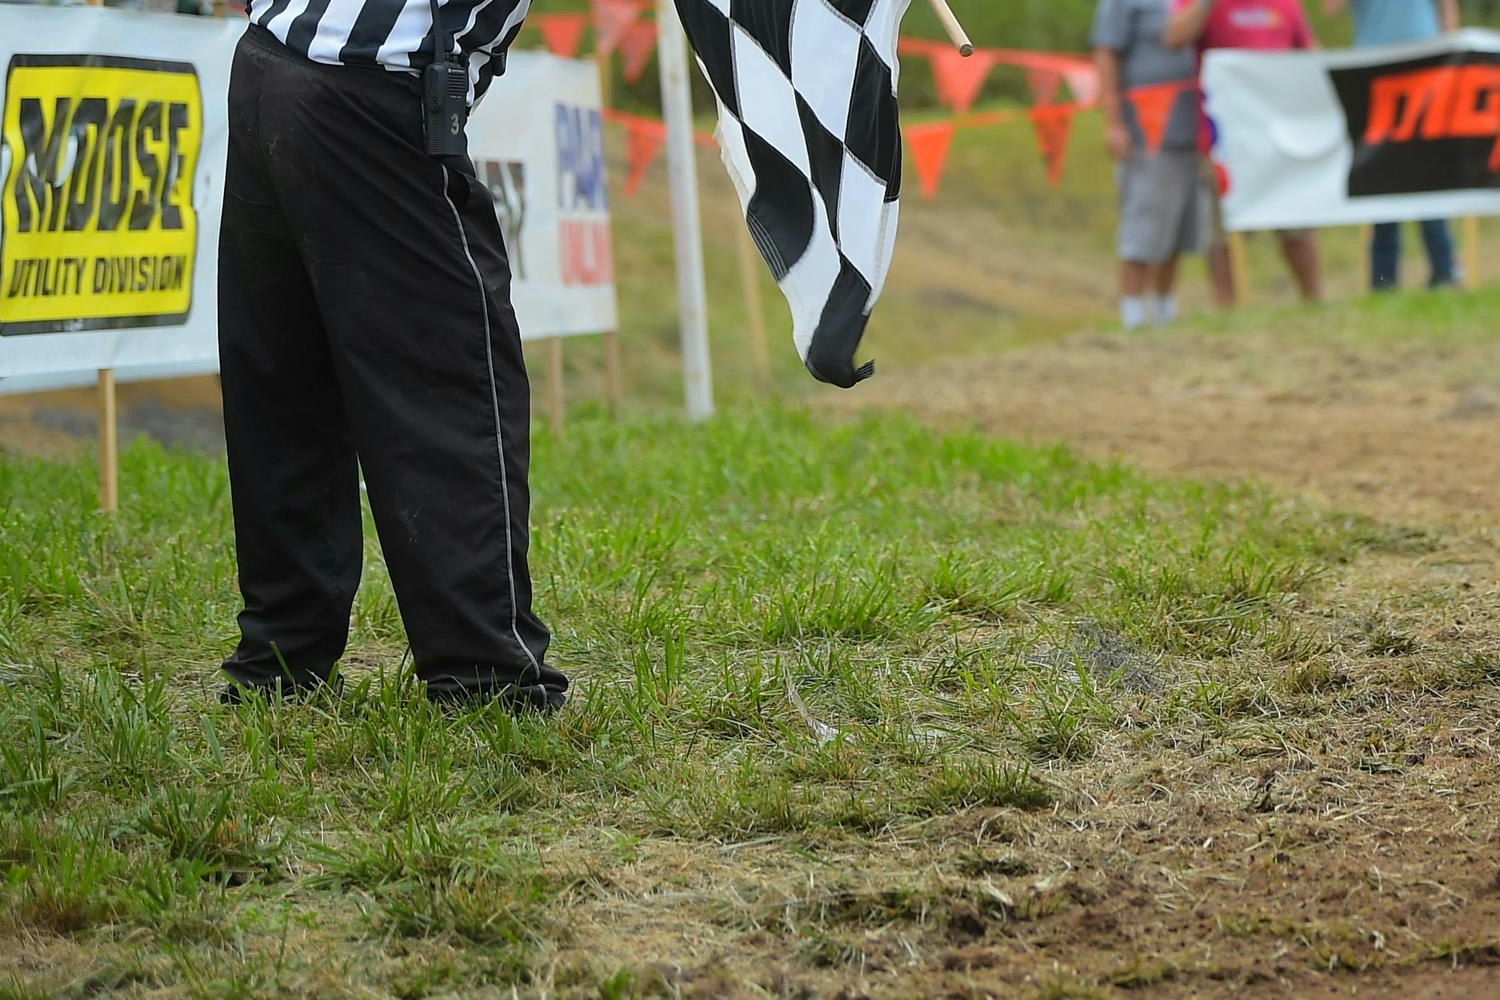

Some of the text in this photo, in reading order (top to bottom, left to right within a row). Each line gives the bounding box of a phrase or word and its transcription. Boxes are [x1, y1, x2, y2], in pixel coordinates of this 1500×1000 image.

[450, 113, 460, 135] 3
[15, 97, 190, 232] MOOSE
[8, 255, 186, 298] UTILITY DIVISION
